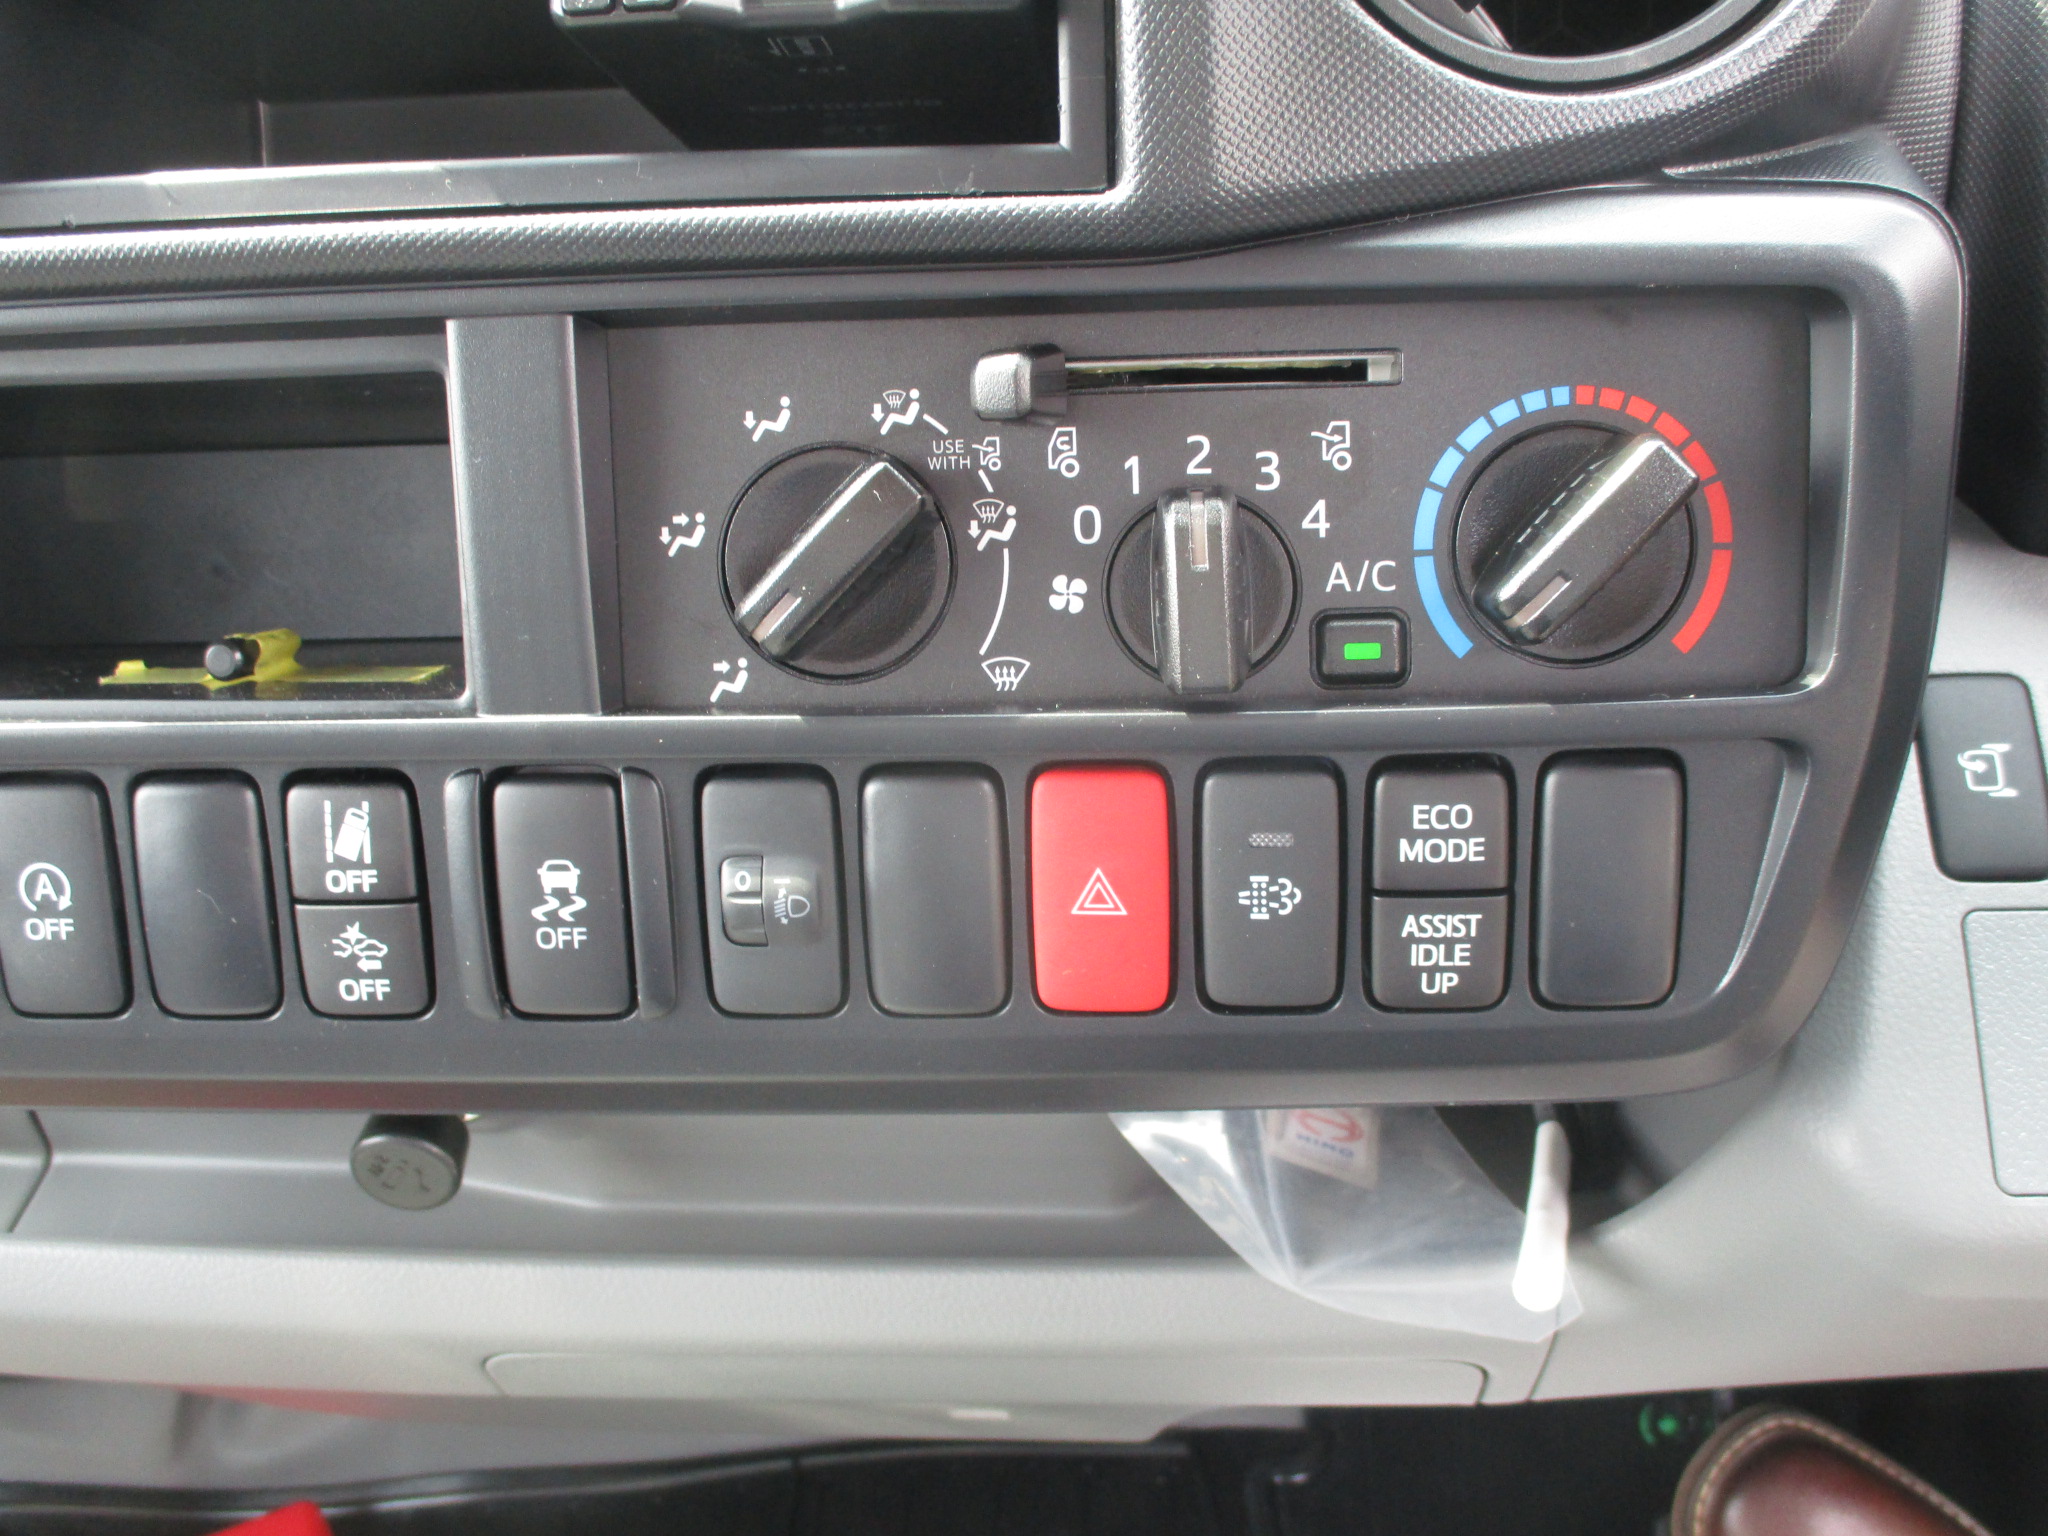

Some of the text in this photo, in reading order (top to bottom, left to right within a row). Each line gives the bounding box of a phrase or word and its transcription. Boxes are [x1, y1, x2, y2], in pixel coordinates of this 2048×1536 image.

[933, 439, 964, 453] USE
[1187, 435, 1212, 474] 2
[928, 456, 970, 470] WITH
[1256, 451, 1280, 491] 3
[1125, 456, 1139, 494] 1
[1074, 505, 1101, 544] 0
[1302, 500, 1330, 537] 4
[1326, 560, 1395, 592] A/C
[1413, 804, 1472, 829] ECO
[1400, 838, 1485, 863] MODE
[325, 870, 377, 893] OFF
[734, 870, 752, 892] 0
[24, 918, 74, 940] OFF
[1402, 914, 1482, 938] ASSIST
[536, 927, 587, 949] OFF
[1411, 944, 1471, 966] IDLE
[339, 979, 390, 1001] OFF
[1421, 973, 1459, 994] UP
